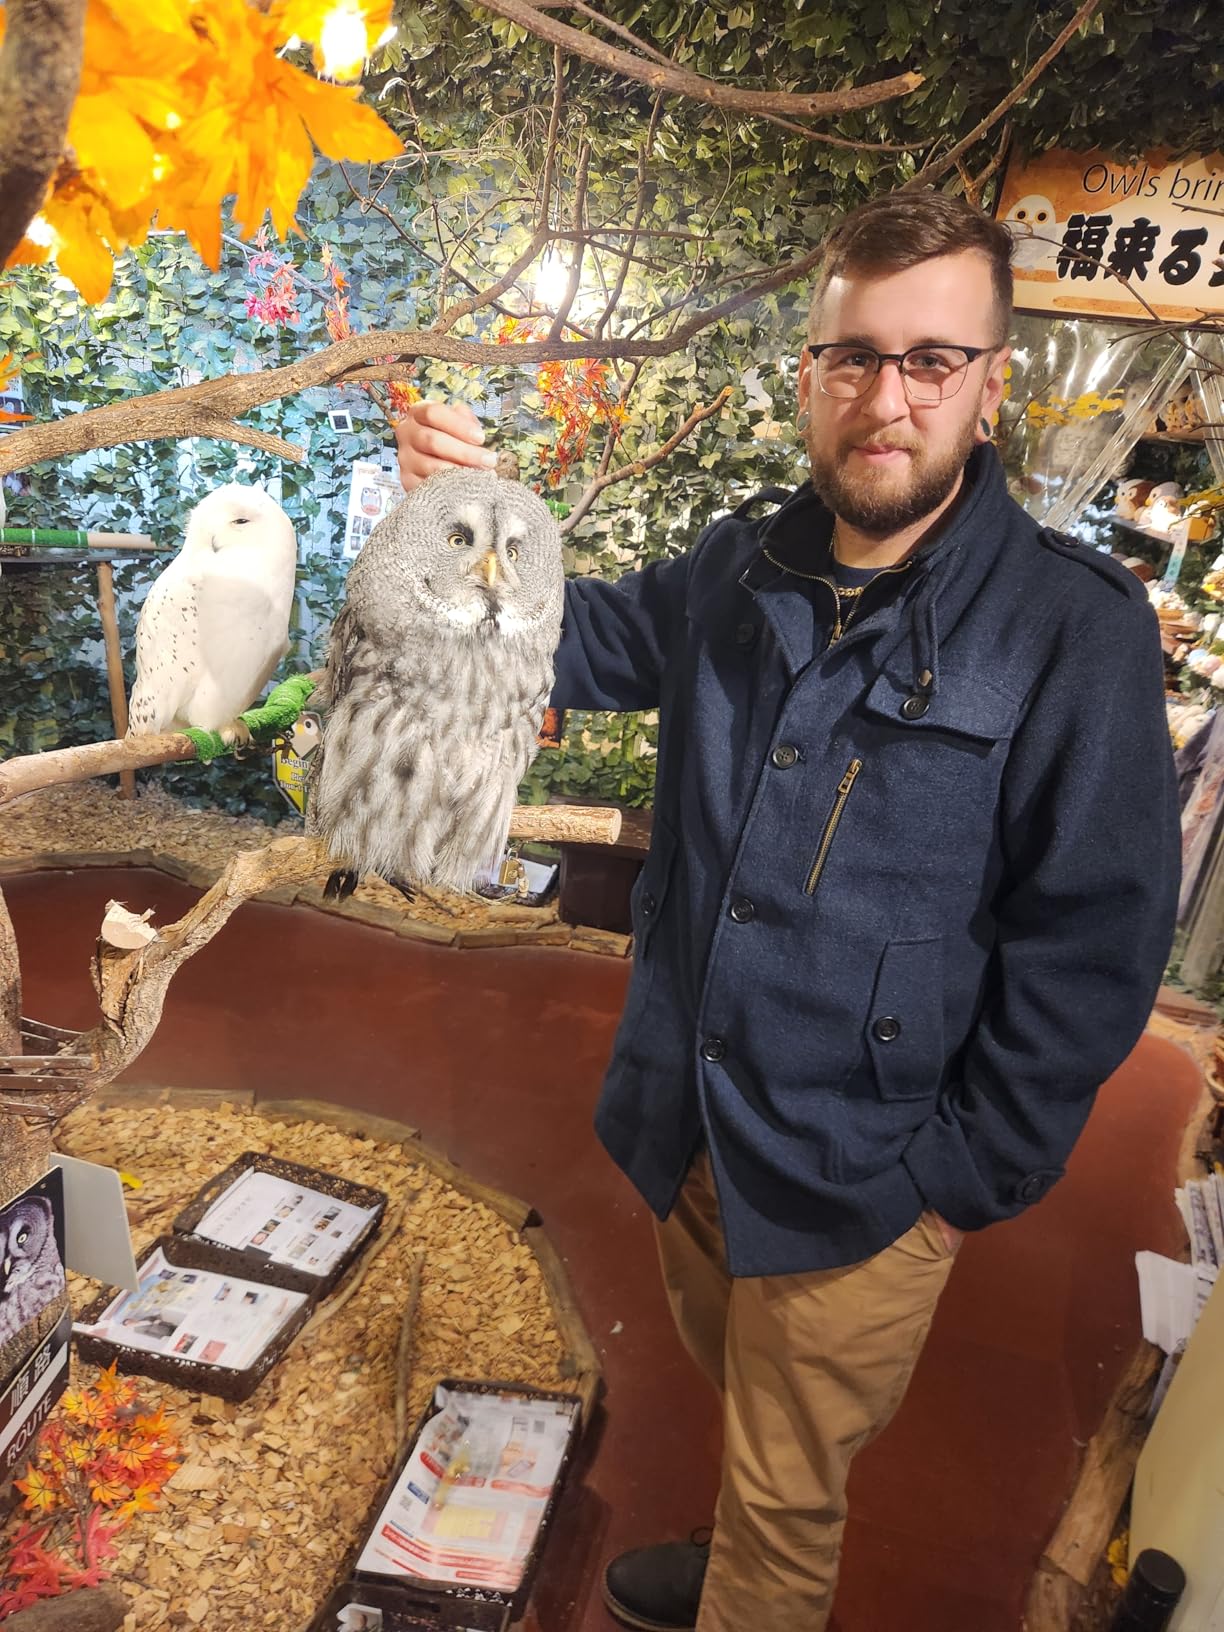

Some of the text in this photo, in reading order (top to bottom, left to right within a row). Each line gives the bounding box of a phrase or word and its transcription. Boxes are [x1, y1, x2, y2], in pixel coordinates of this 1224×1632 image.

[1083, 163, 1161, 197] Owls
[1056, 213, 1224, 287] 福来る
[7, 1390, 52, 1467] ROUTE
